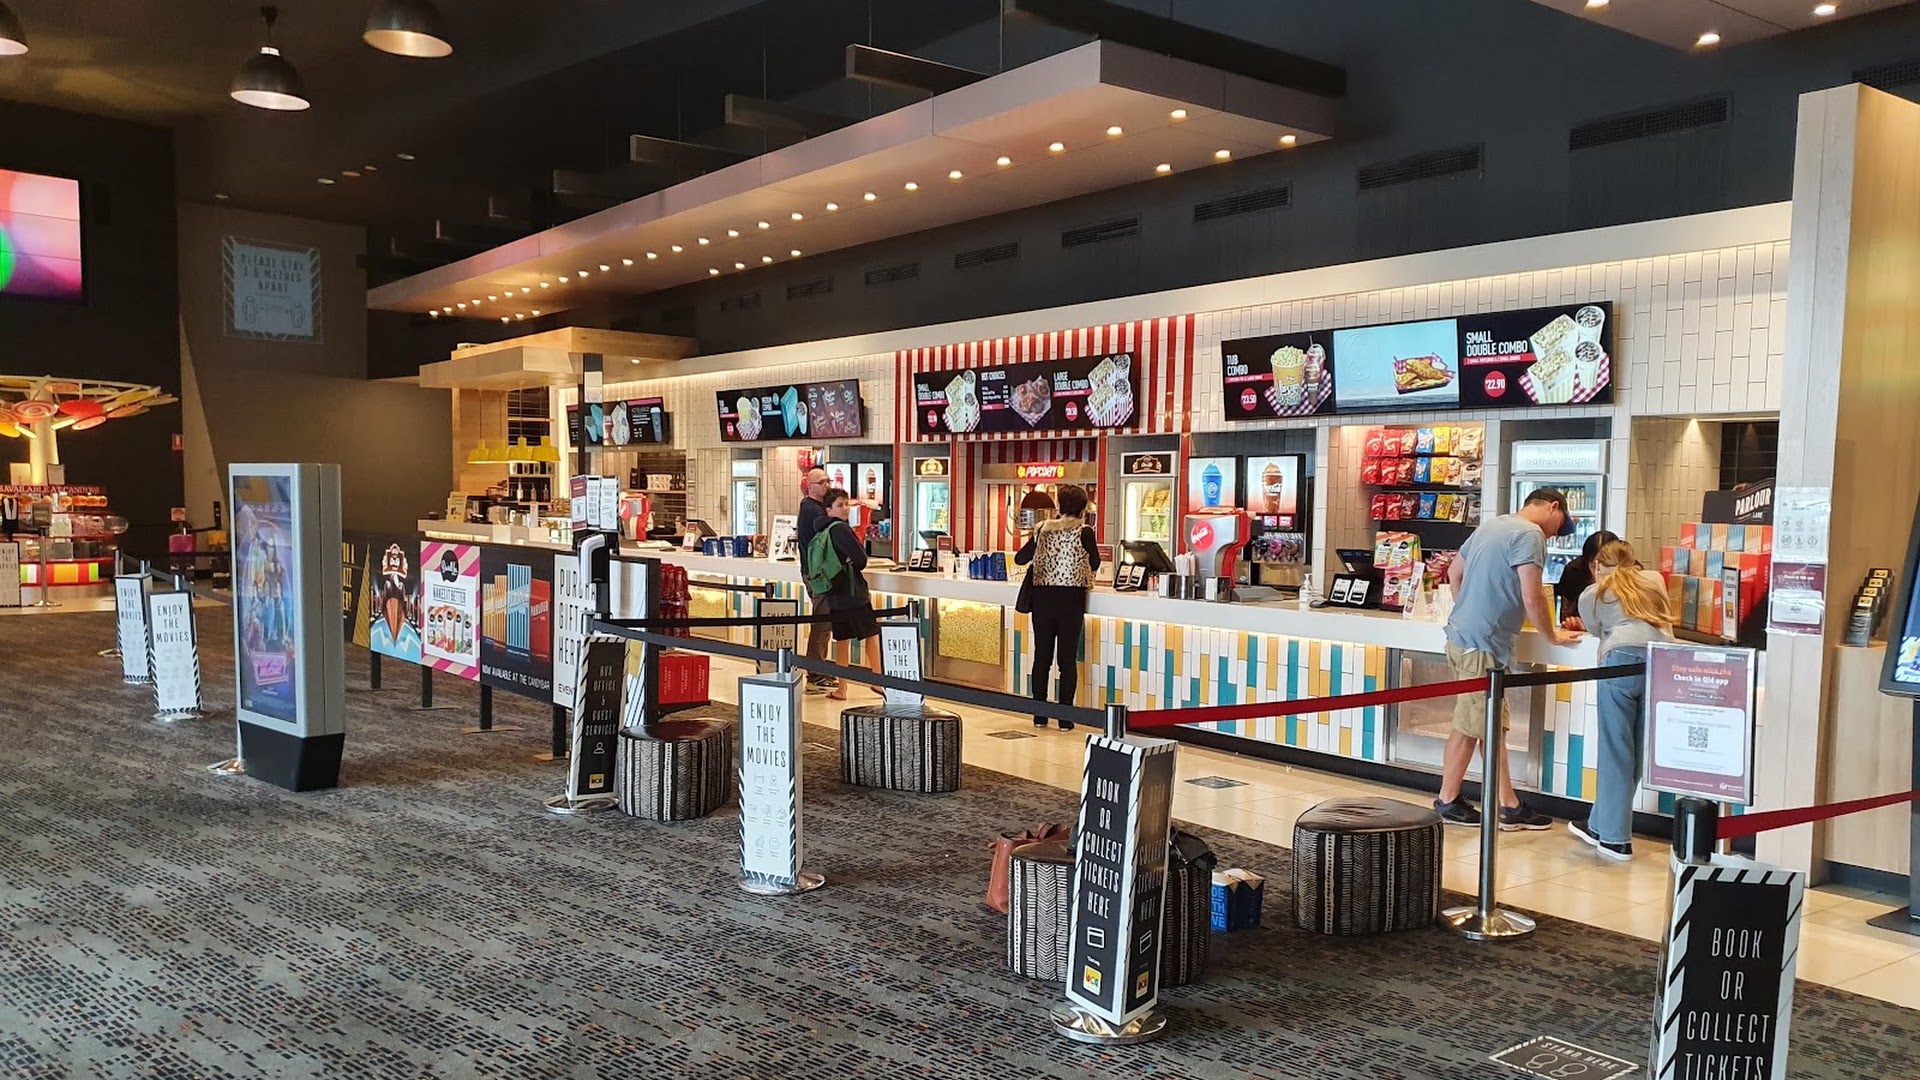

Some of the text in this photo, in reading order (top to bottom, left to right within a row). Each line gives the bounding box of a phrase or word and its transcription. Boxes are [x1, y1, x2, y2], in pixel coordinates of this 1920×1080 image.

[1466, 331, 1493, 344] SMALL
[1467, 340, 1528, 356] DOUBLE COMBO
[1226, 354, 1238, 365] TUB
[1227, 364, 1248, 376] COMBO
[1054, 379, 1089, 391] DOUBLE COMBO
[1026, 466, 1057, 478] POPCORN
[1735, 487, 1772, 516] PARLOUR
[120, 587, 138, 600] ENJOY
[124, 600, 135, 610] THE
[158, 604, 184, 618] ENJOY
[121, 610, 142, 621] MOVIES
[164, 618, 179, 630] THE
[772, 626, 786, 636] THE
[156, 631, 190, 644] MOVIES
[888, 639, 912, 654] ENJOY
[894, 654, 908, 666] THE
[1674, 674, 1693, 682] Check
[594, 680, 616, 692] OFFICE
[592, 710, 612, 722] GUEST
[750, 702, 782, 724] ENJOY
[586, 724, 616, 736] SERVICES
[756, 726, 775, 744] THE
[746, 750, 786, 768] MOVIES
[1096, 777, 1120, 804] BOOK
[1100, 808, 1111, 830] OR
[1085, 831, 1122, 864] COLLECT
[1084, 860, 1120, 894] TICKETS
[1087, 891, 1110, 920] HERE
[1712, 928, 1762, 958] BOOK
[1720, 970, 1744, 1000] OR
[1686, 1010, 1770, 1044] COLLECT
[1540, 1042, 1620, 1071] STAND HERE
[1685, 1053, 1764, 1080] TICKETS
